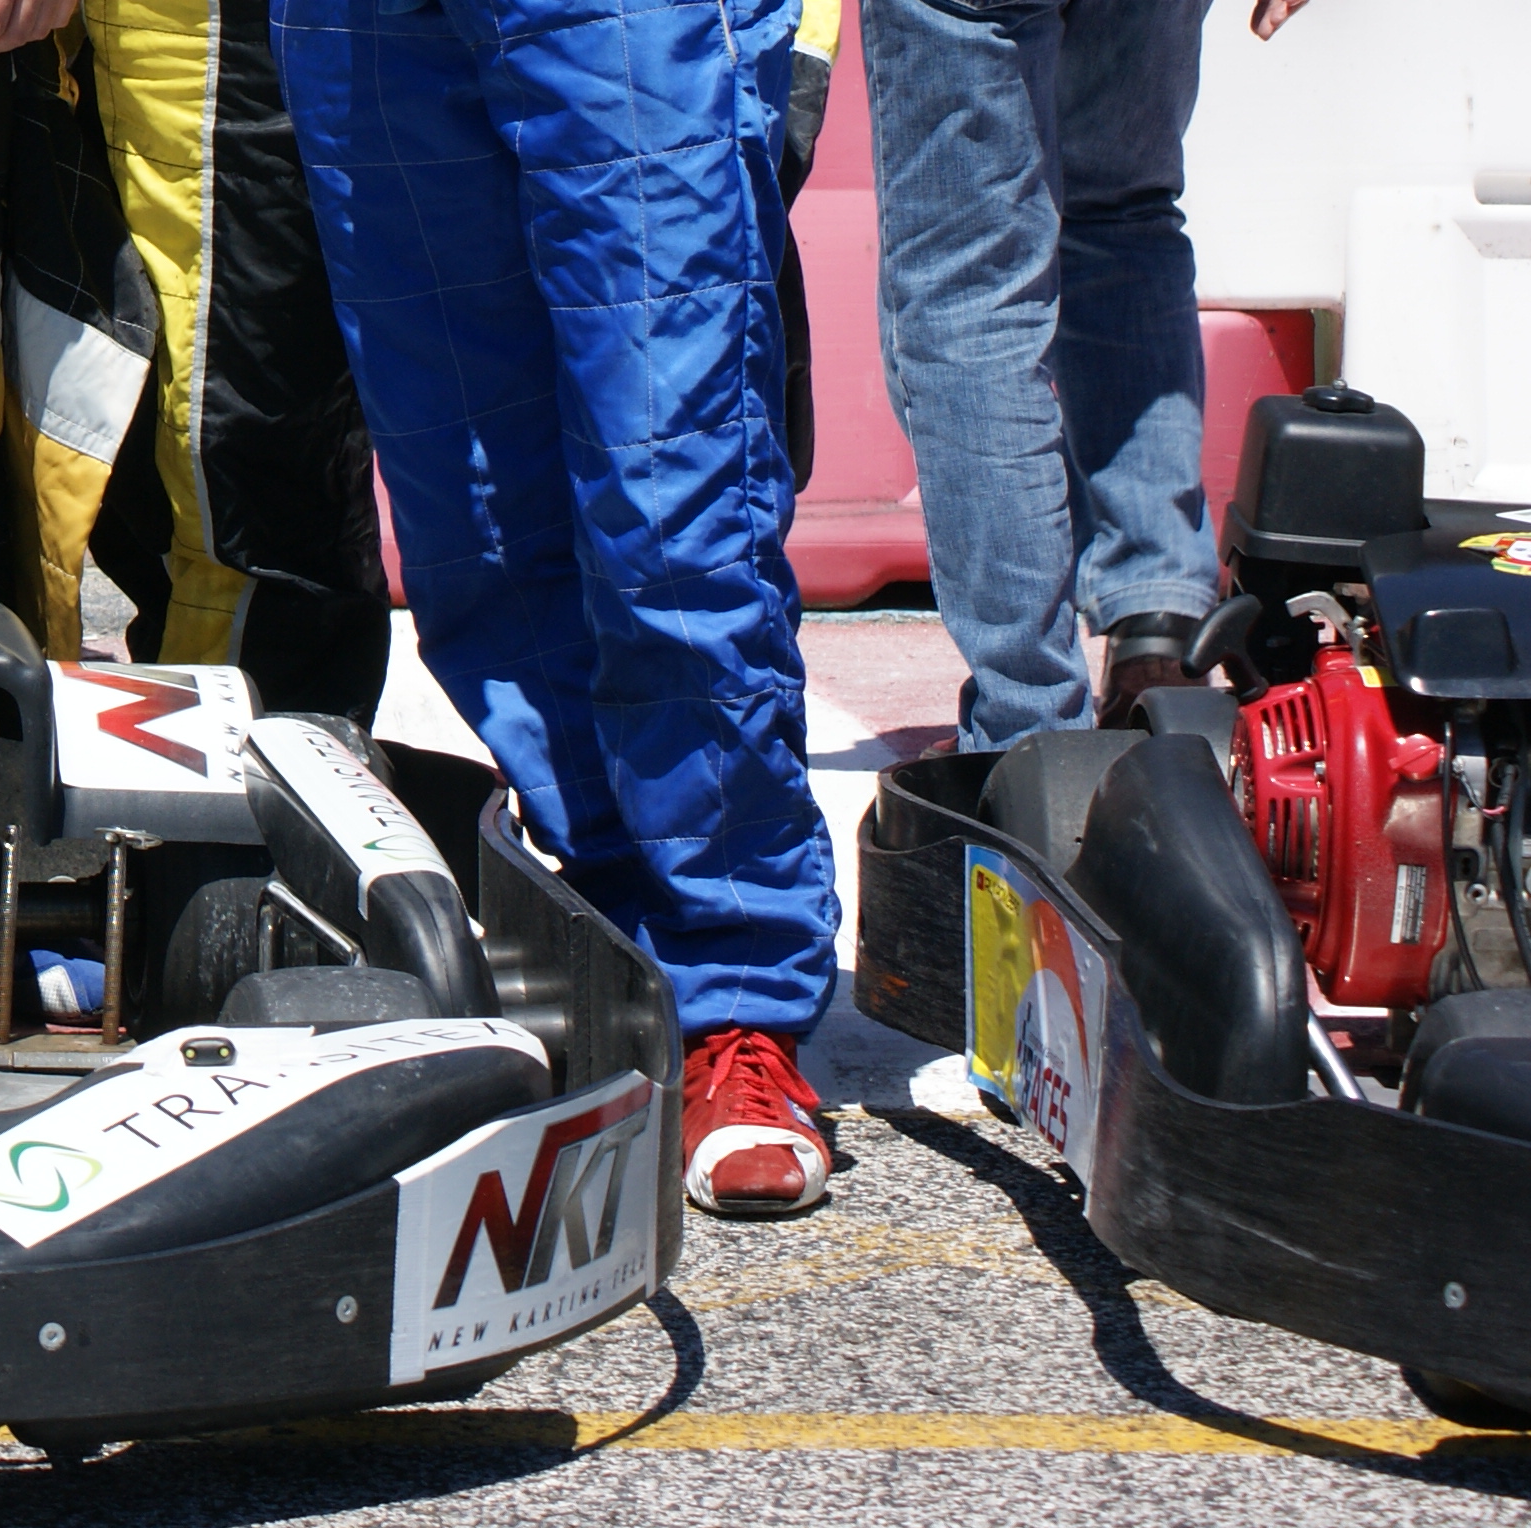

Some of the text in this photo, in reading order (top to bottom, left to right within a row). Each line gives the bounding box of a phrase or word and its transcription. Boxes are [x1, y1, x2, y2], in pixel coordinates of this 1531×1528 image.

[102, 1020, 525, 1149] TRAITEX
[432, 1079, 653, 1311] NKT
[428, 1321, 489, 1353] NEW
[509, 1288, 601, 1334] KARTING
